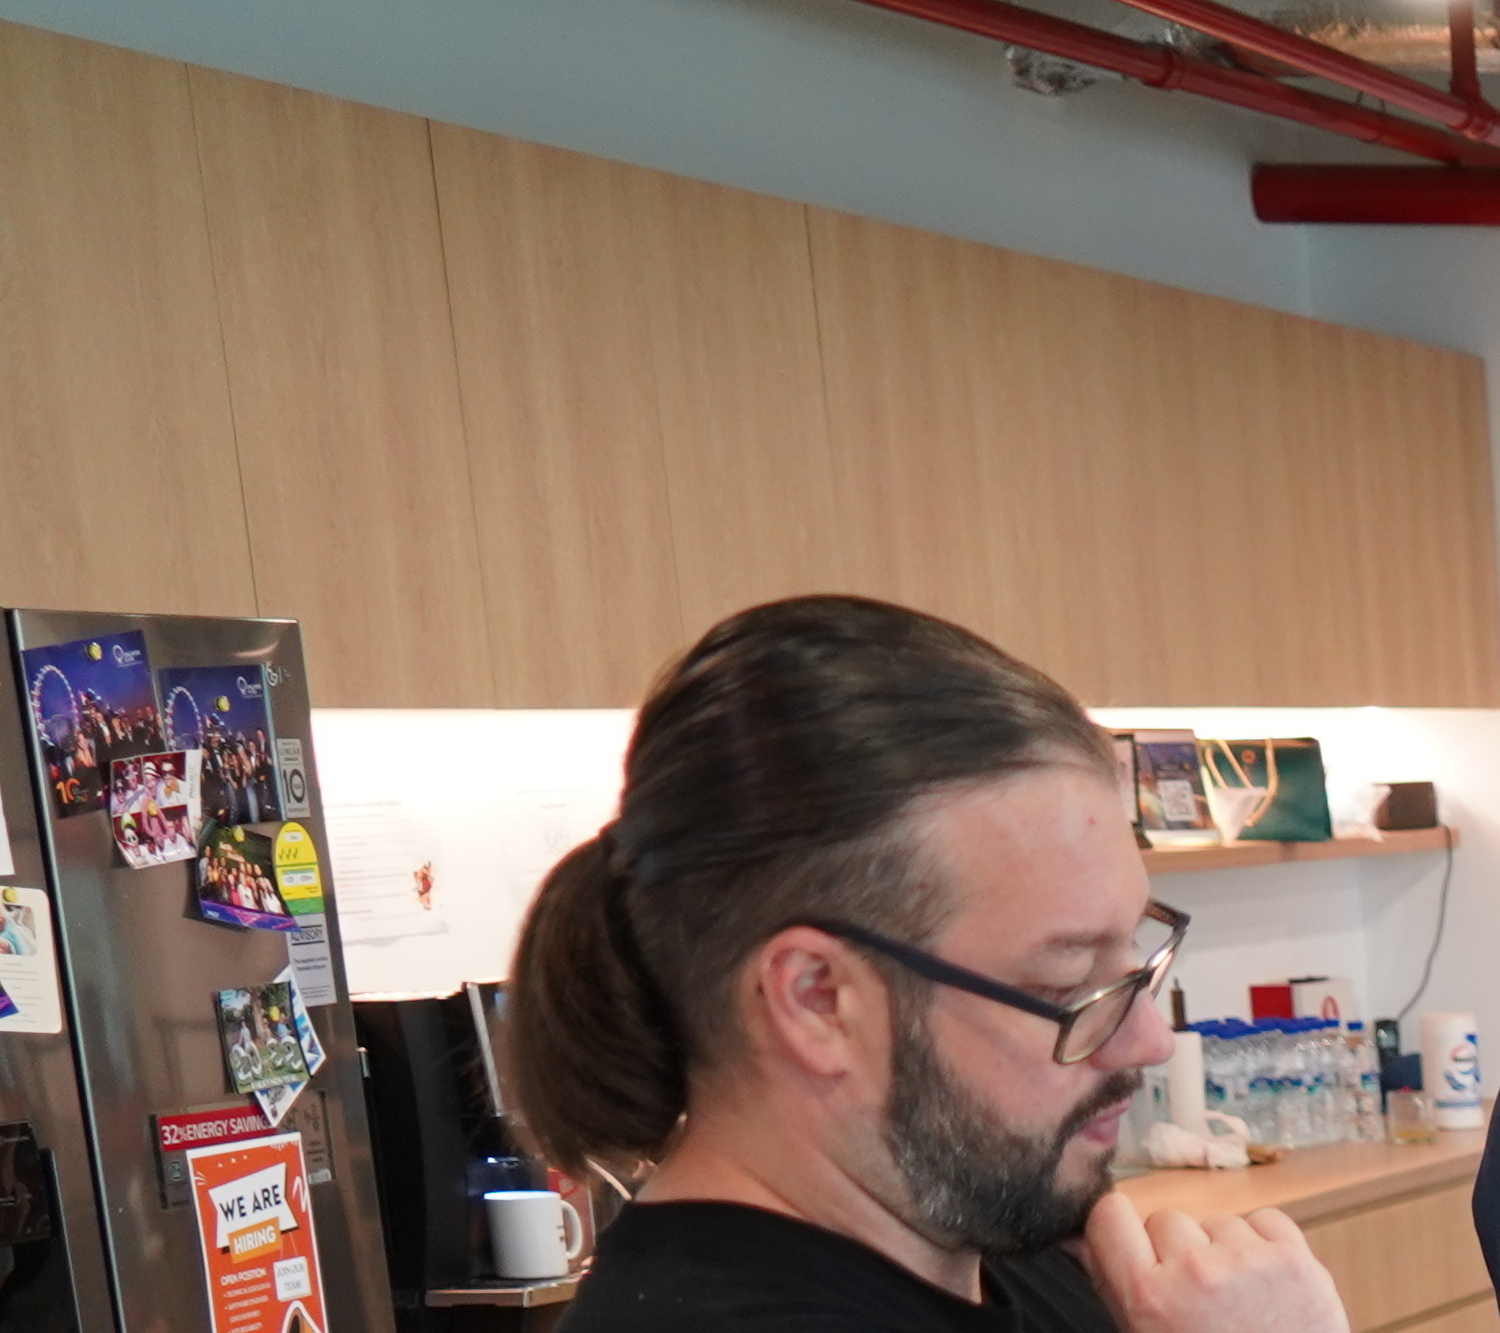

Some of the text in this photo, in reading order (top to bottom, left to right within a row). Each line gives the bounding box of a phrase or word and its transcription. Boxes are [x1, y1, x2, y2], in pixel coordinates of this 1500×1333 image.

[283, 769, 305, 804] 10
[219, 1185, 282, 1222] WE ARE
[232, 1225, 276, 1254] HIRING
